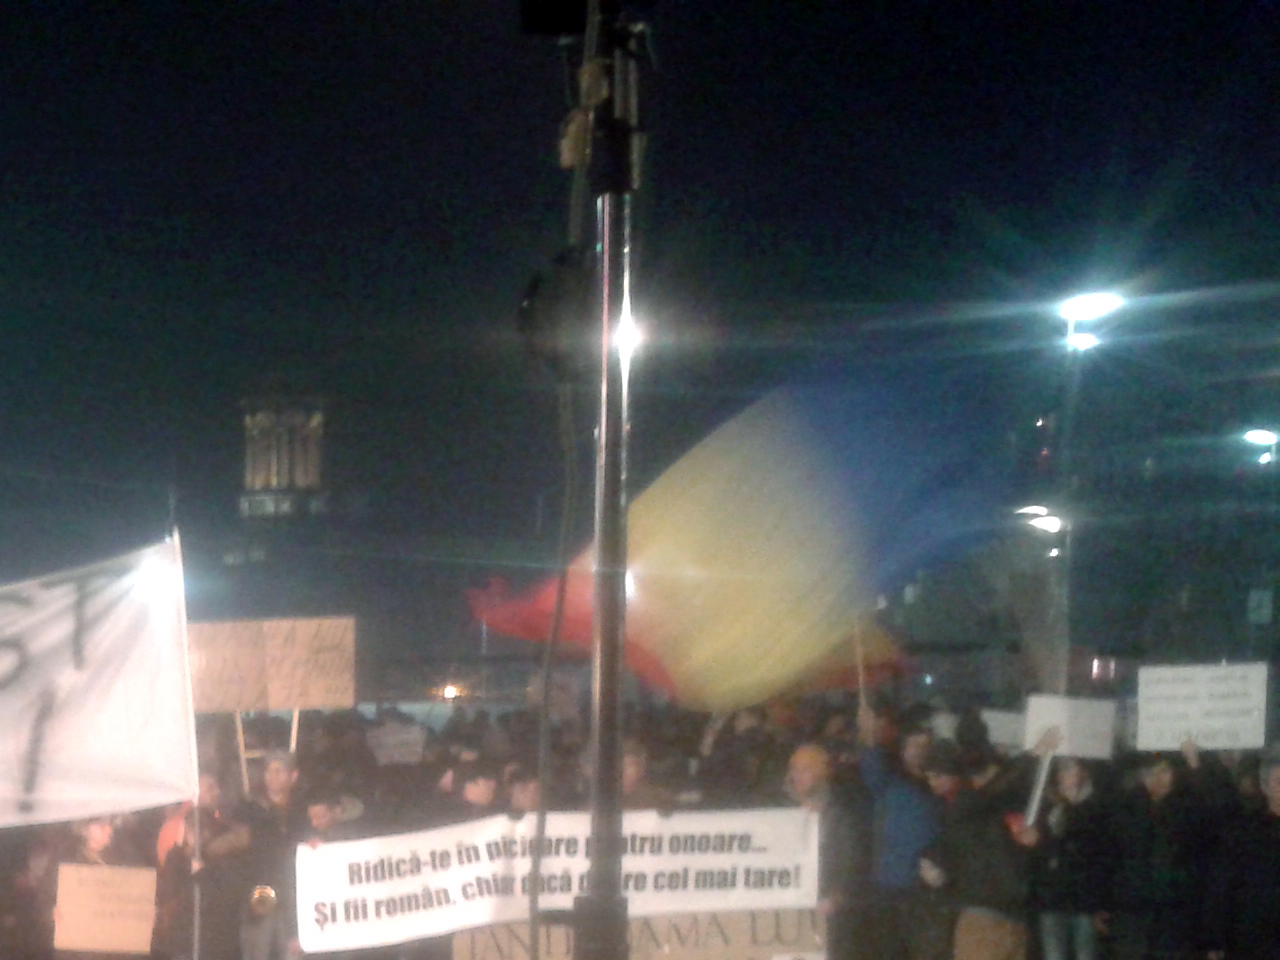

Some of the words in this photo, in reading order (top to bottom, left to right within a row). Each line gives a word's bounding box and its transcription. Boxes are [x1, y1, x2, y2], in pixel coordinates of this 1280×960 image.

[348, 849, 451, 885] Ridică-te
[585, 834, 663, 858] ptru
[578, 868, 647, 894] dre
[654, 867, 688, 891] cel
[694, 865, 737, 890] mai
[744, 864, 801, 889] tare!
[620, 912, 730, 950] AMA
